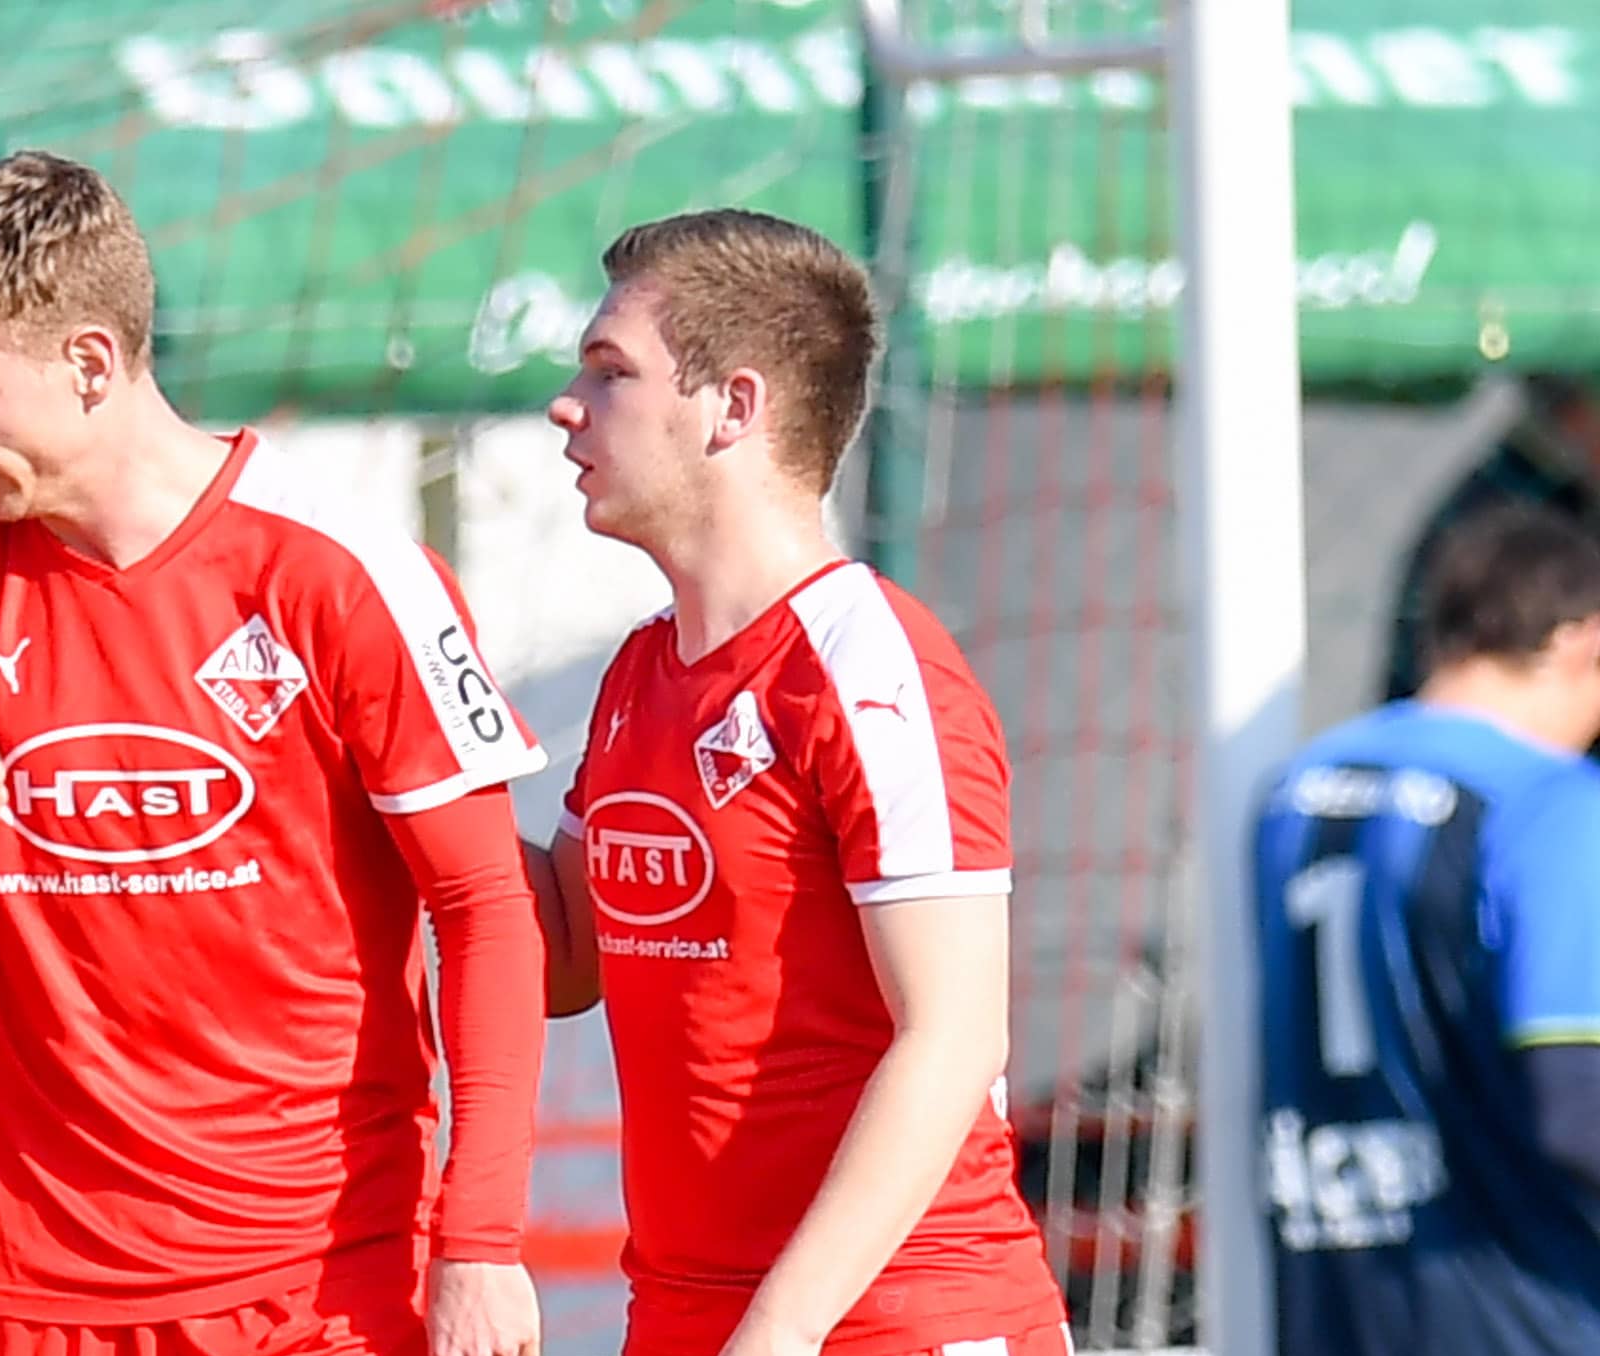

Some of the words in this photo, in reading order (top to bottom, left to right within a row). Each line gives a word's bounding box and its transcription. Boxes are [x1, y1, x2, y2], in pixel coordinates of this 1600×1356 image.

[220, 632, 280, 674] ATSV
[438, 625, 504, 743] UCD
[13, 769, 226, 817] HAST
[587, 827, 691, 887] HAST
[1285, 855, 1377, 1077] 1
